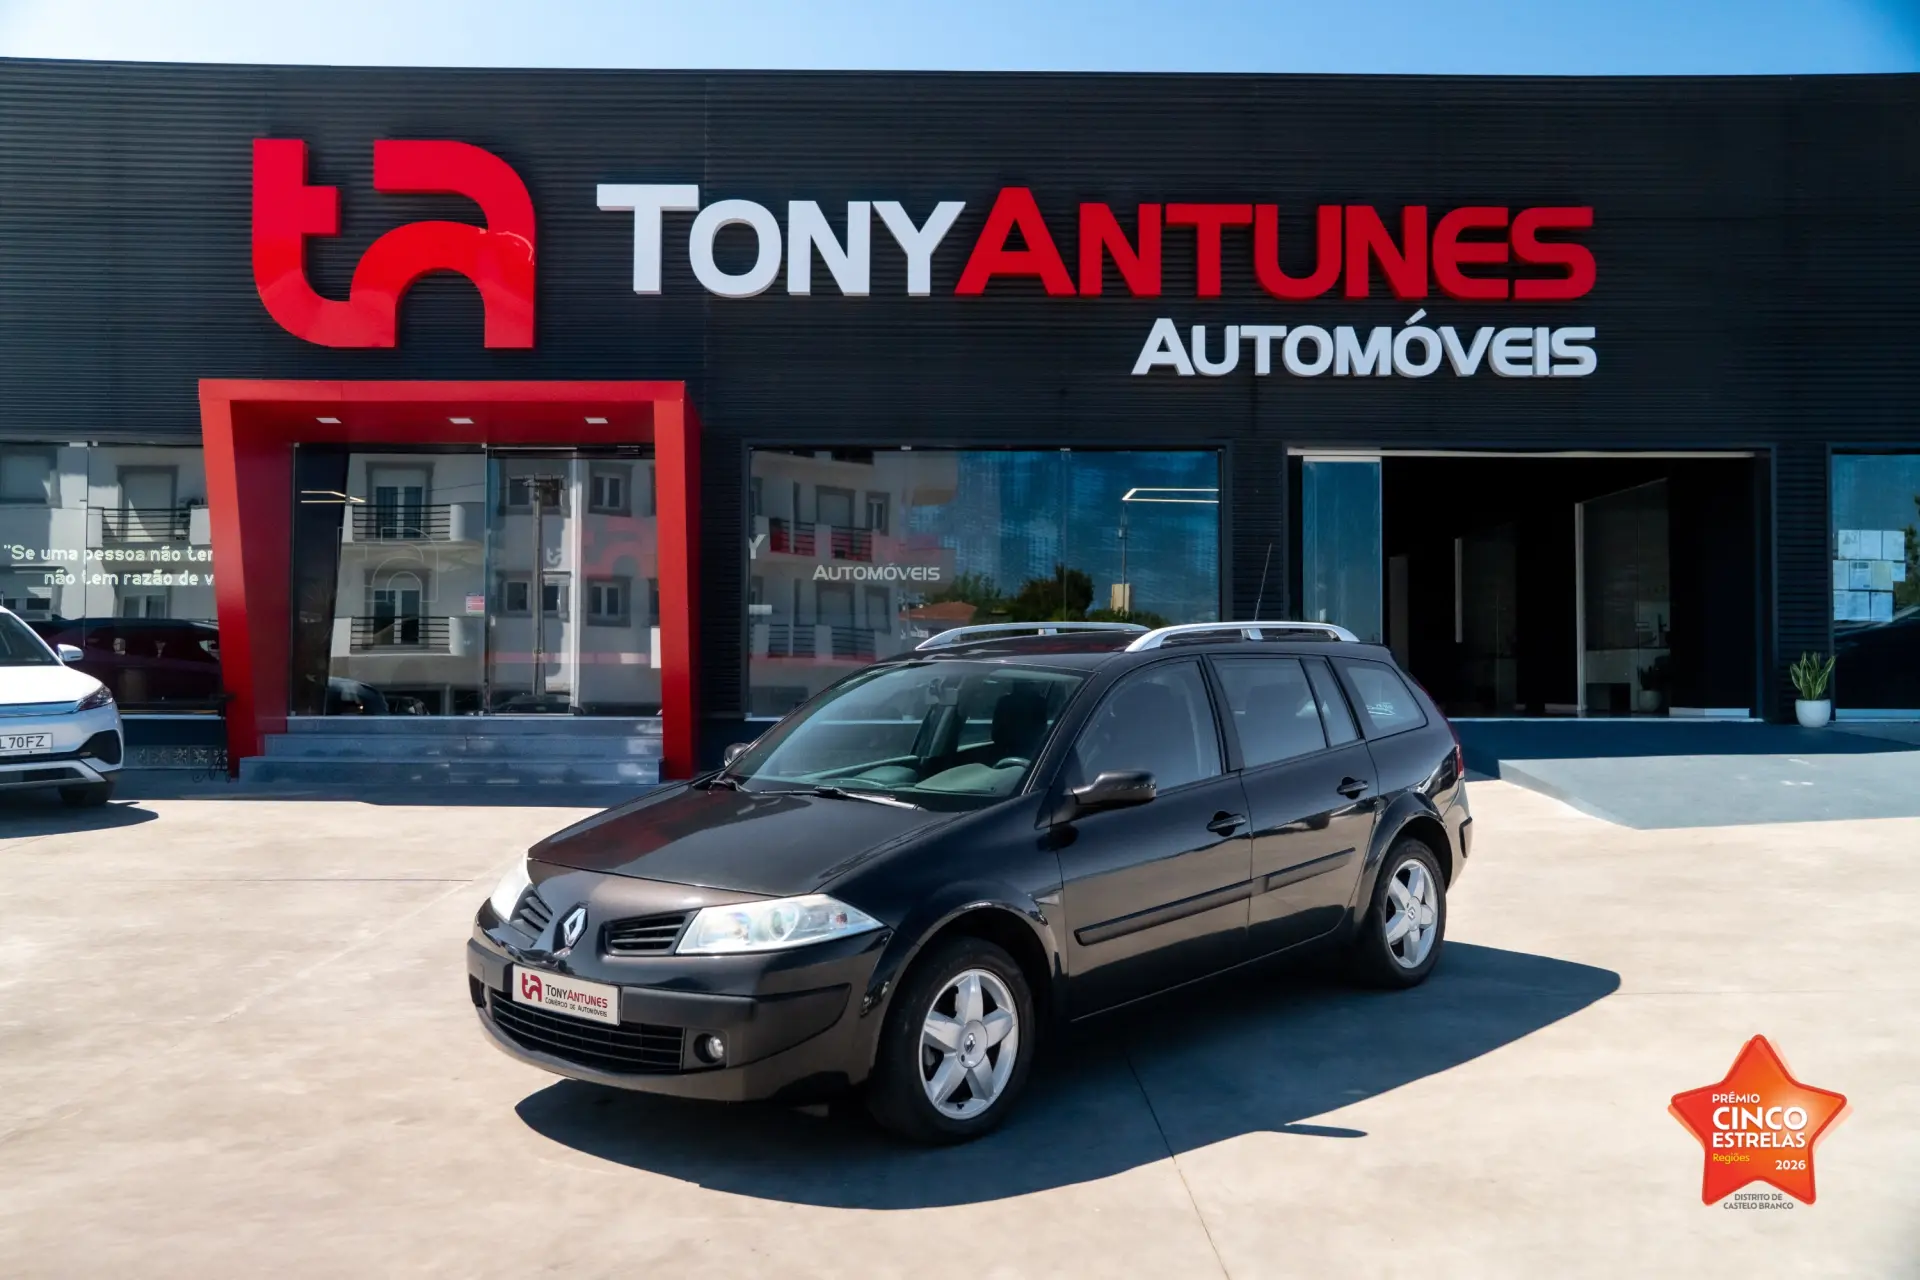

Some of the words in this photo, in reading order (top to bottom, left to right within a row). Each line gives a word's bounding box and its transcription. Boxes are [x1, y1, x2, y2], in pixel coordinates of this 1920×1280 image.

[1131, 308, 1597, 378] AUTOMÓVEIS
[41, 549, 78, 561] uma
[83, 549, 146, 565] pessoa
[150, 546, 181, 562] não
[44, 569, 76, 586] não
[81, 570, 119, 586] tem
[123, 569, 173, 586] razão
[178, 570, 200, 586] de
[812, 562, 941, 581] AUTOMÓVEIS
